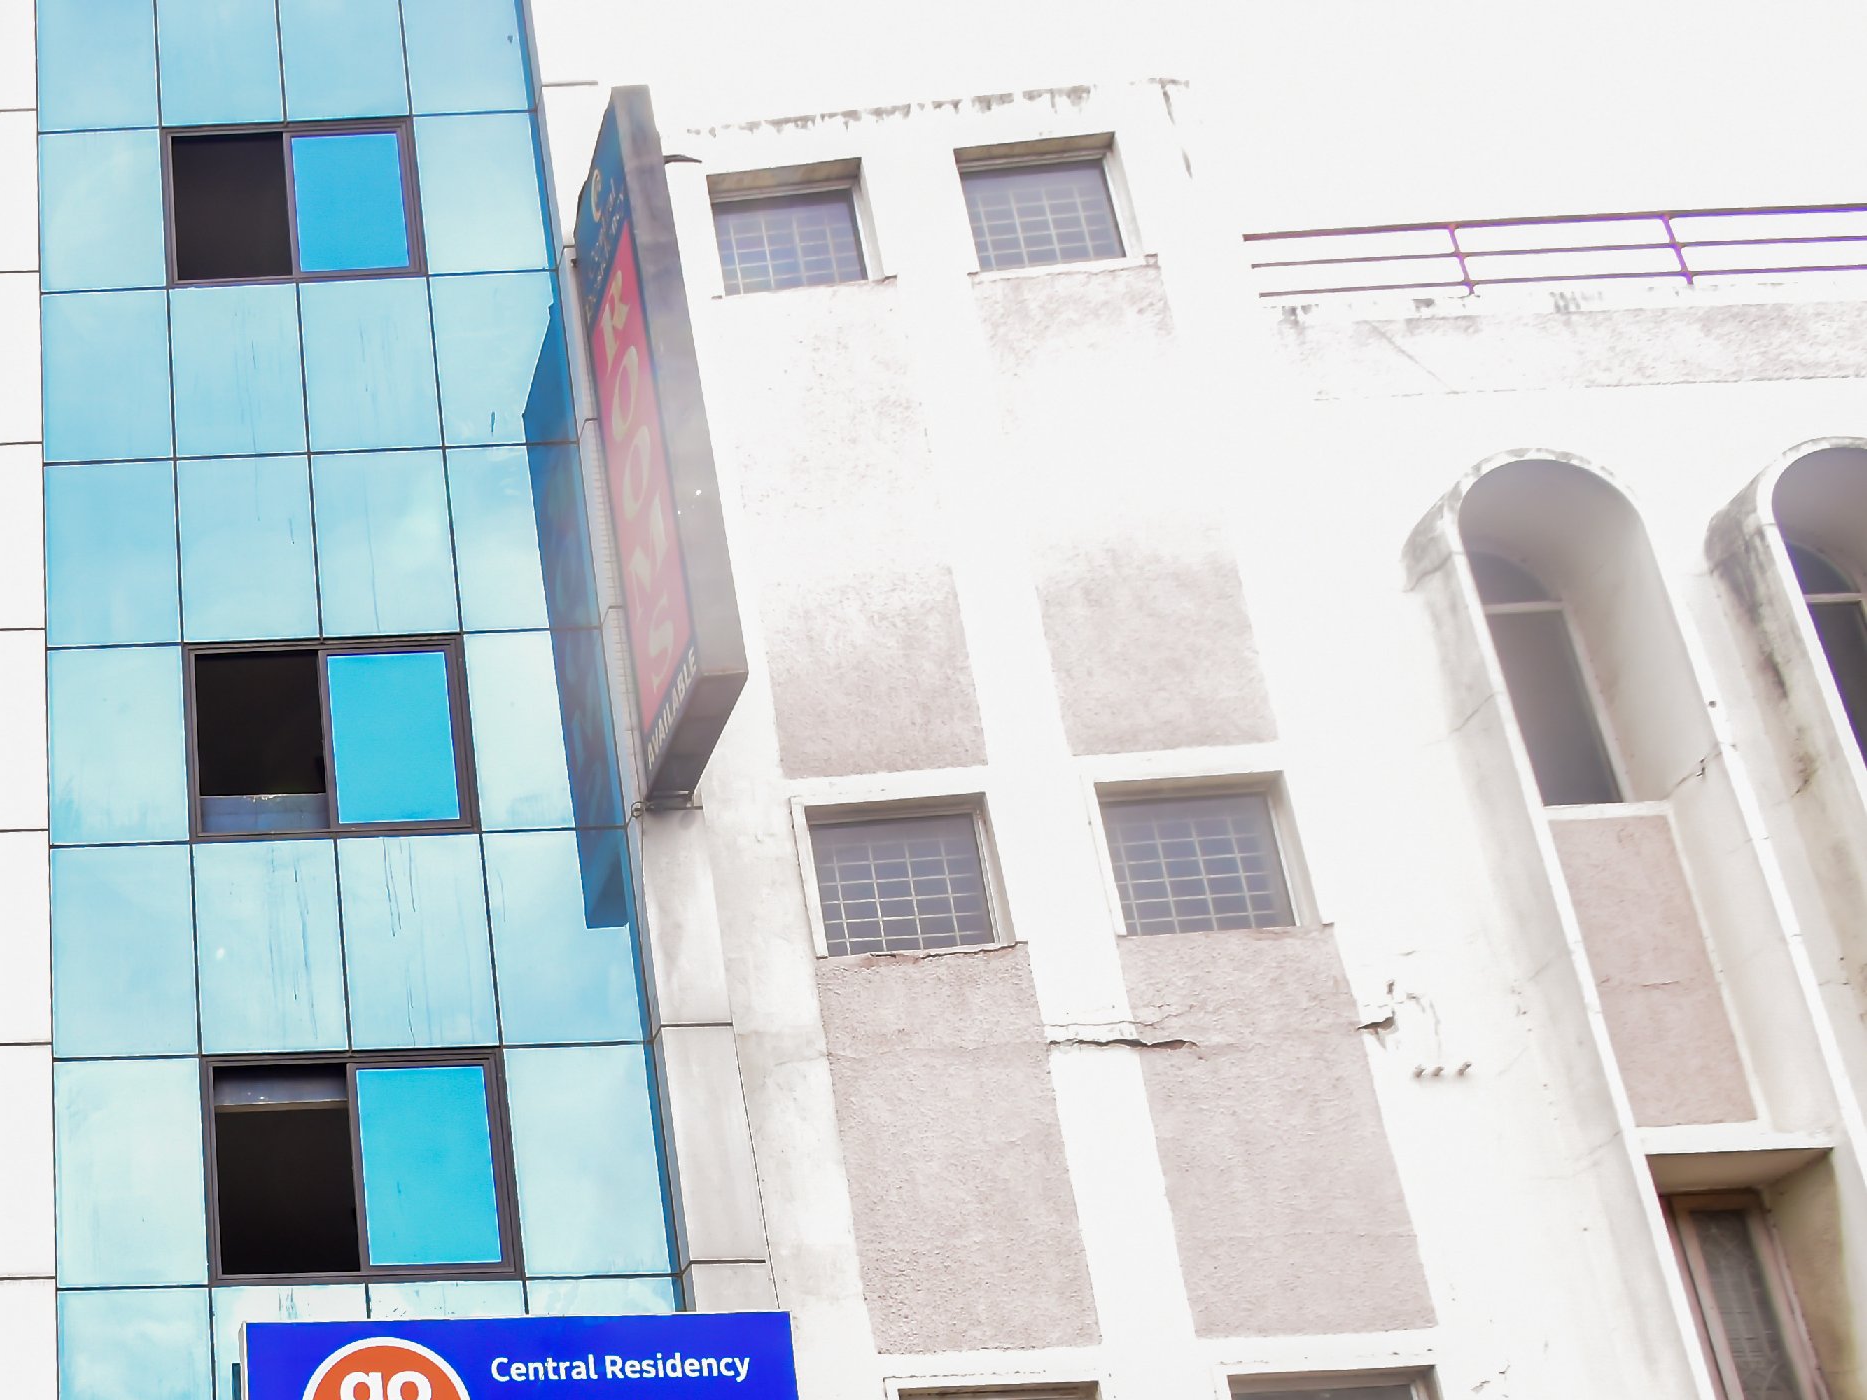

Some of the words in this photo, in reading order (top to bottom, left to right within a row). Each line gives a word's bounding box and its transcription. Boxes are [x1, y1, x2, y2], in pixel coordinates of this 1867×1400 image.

[601, 269, 674, 695] ROOMS
[646, 646, 697, 770] AVAILABLE
[490, 1353, 599, 1382] Central
[604, 1352, 751, 1382] Residency
